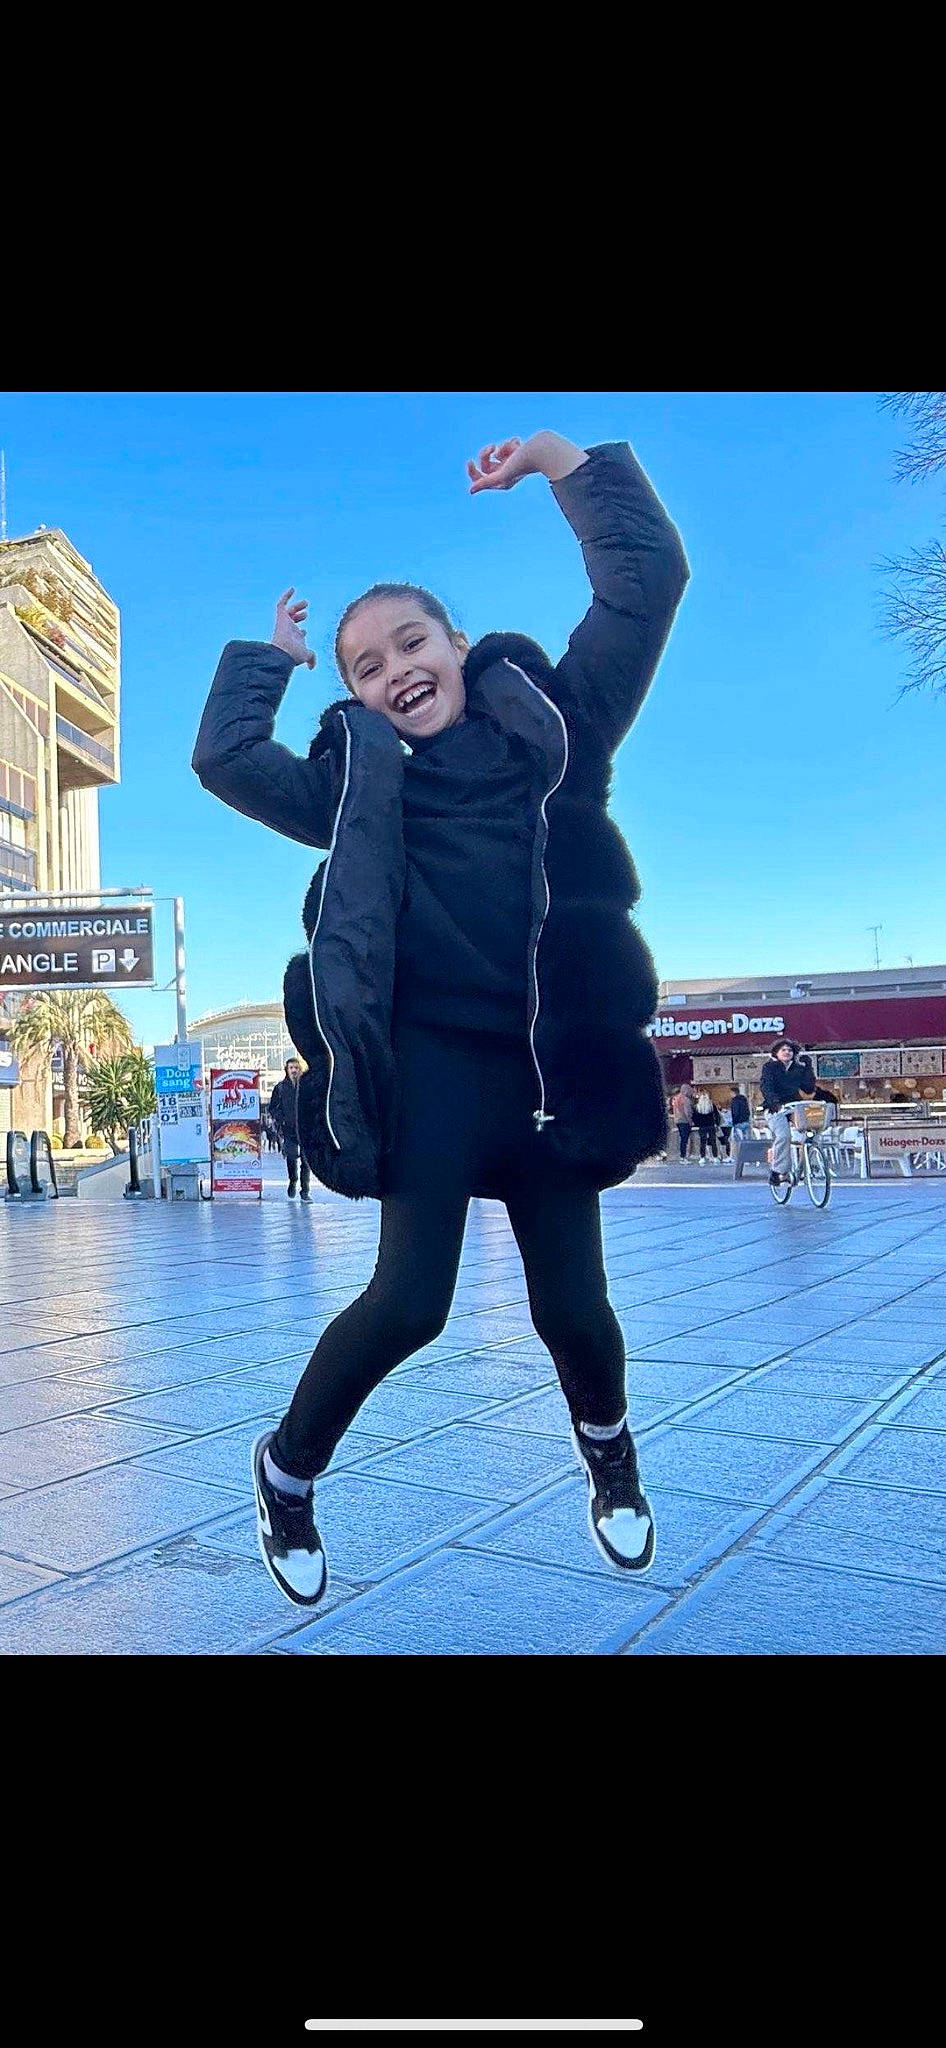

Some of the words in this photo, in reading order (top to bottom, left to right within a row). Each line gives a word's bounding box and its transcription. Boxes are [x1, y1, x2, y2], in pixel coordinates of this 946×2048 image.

[8, 918, 149, 938] COMMERCIALE
[166, 1068, 190, 1079] Don
[161, 1079, 191, 1089] sang
[160, 1097, 177, 1107] 18
[160, 1113, 178, 1122] 01
